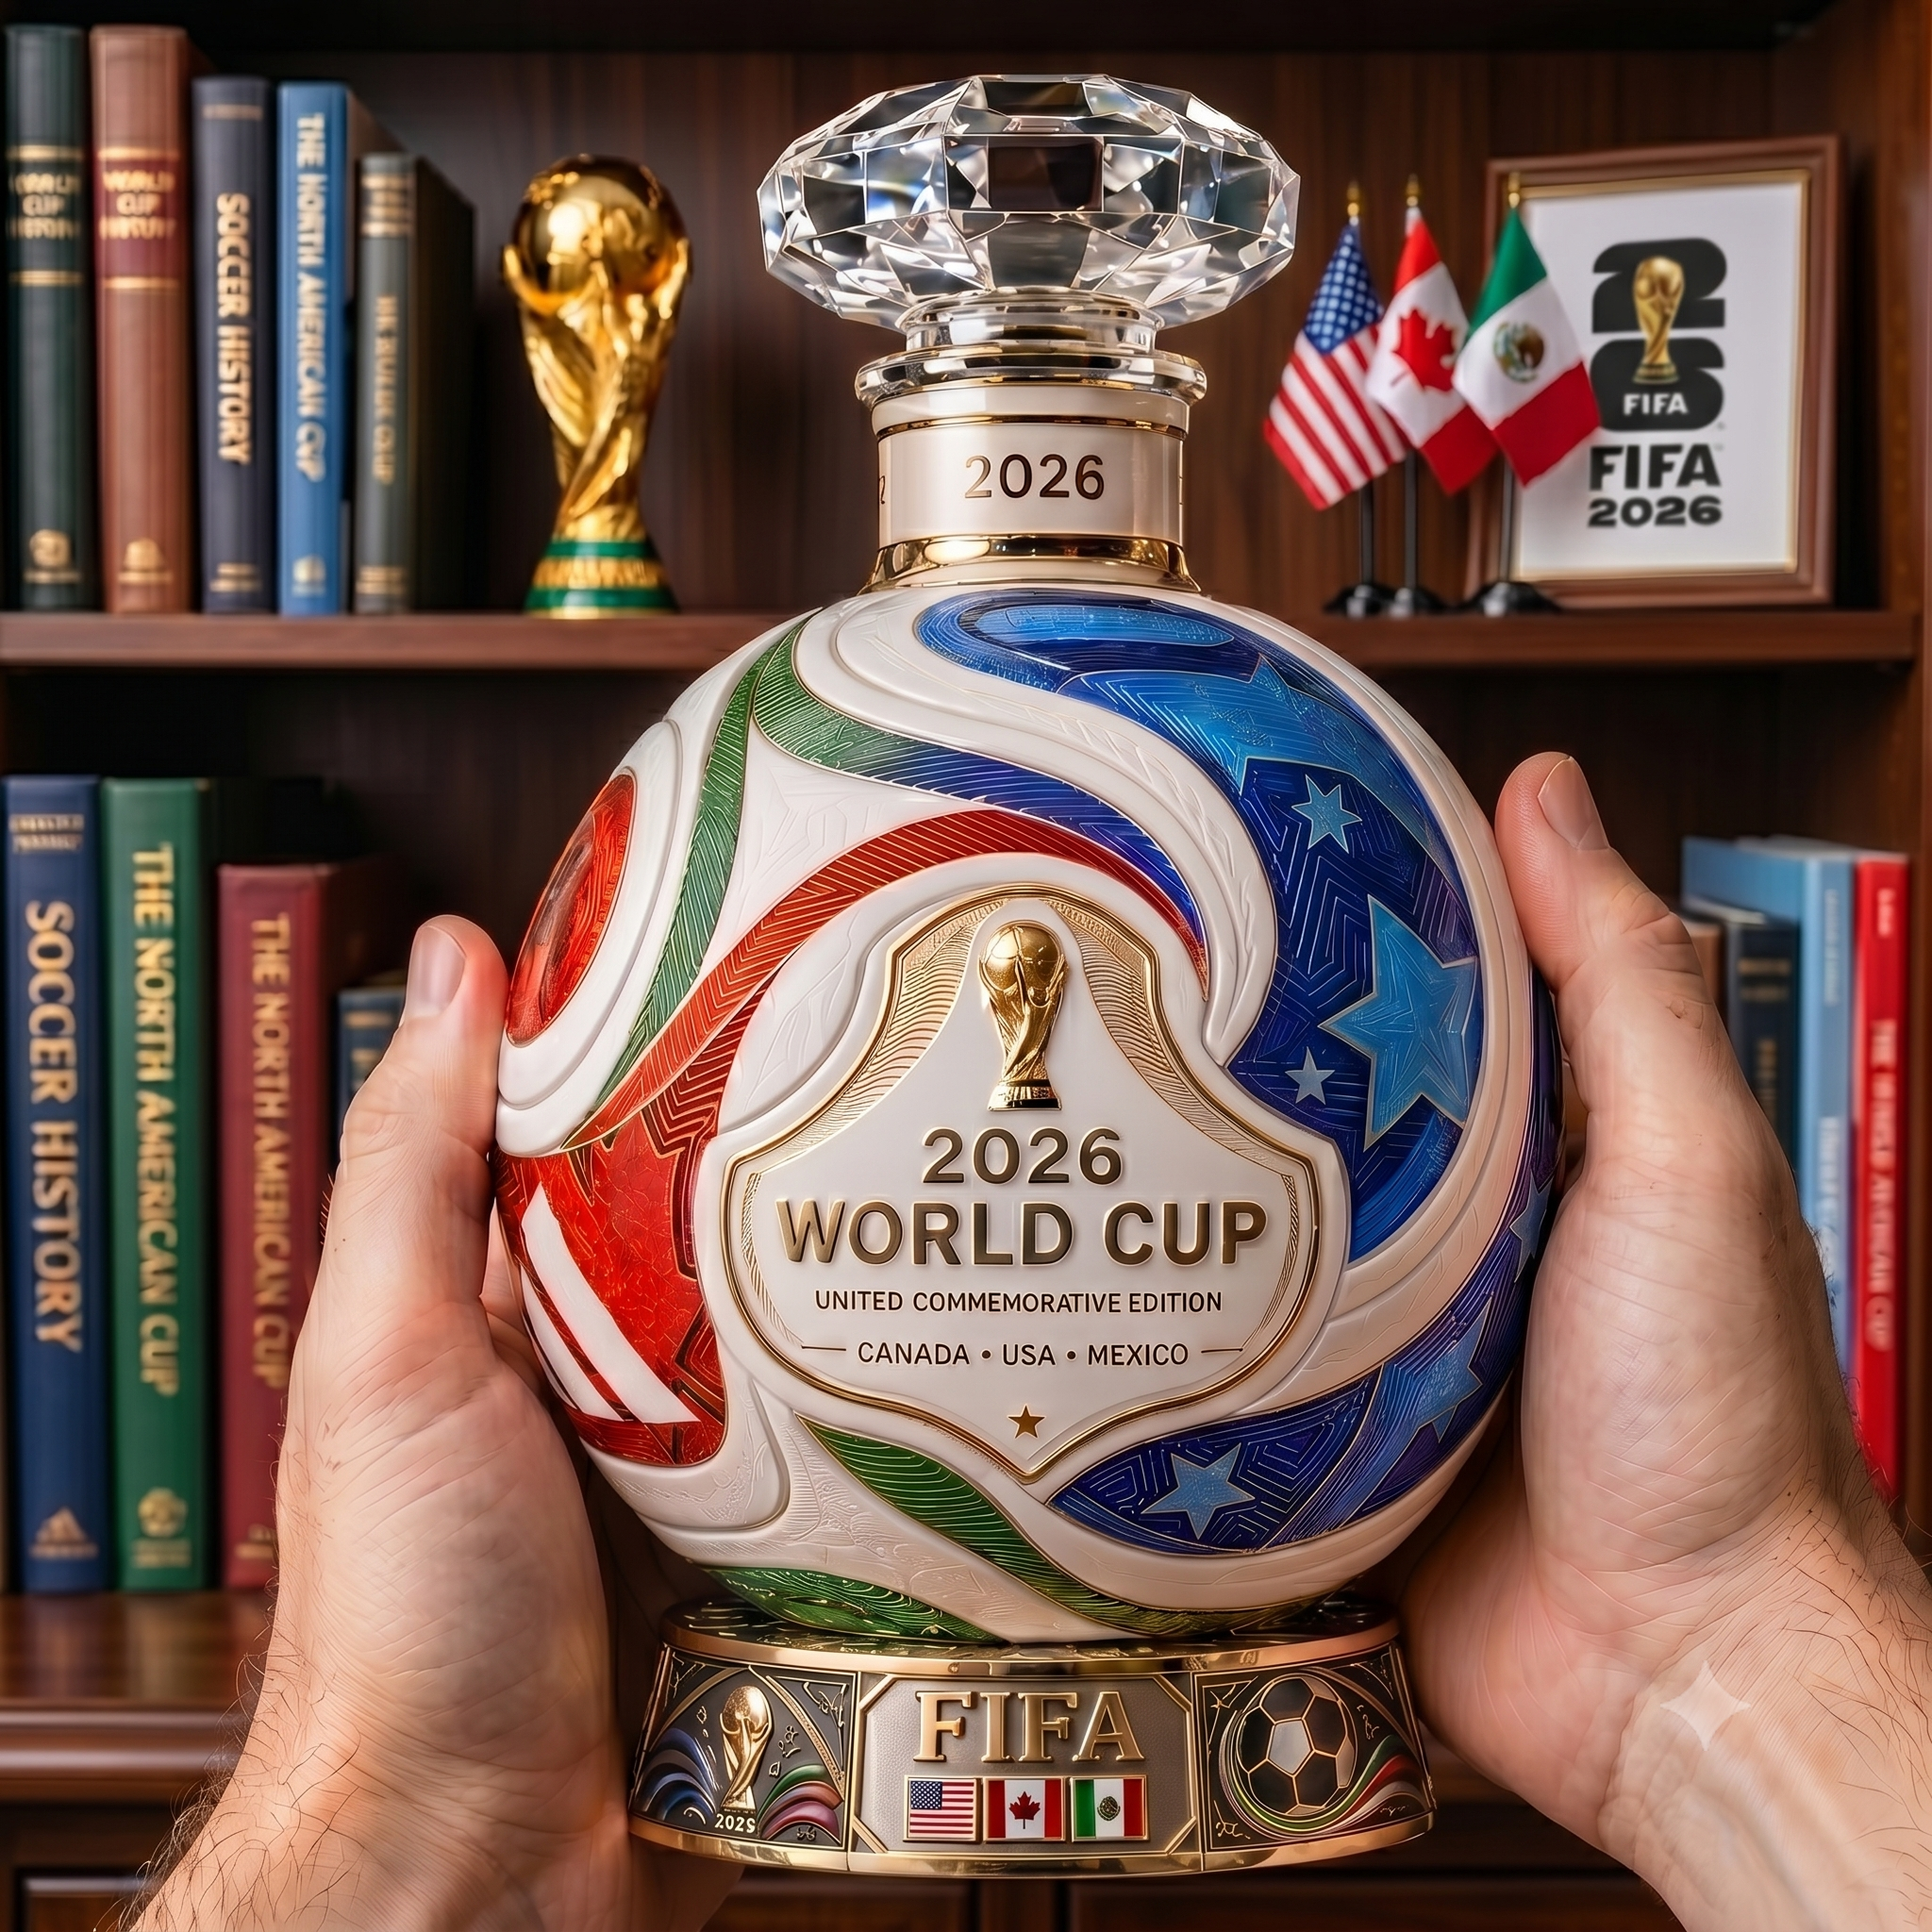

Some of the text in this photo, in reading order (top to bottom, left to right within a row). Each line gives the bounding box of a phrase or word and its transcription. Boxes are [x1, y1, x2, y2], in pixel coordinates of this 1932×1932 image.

[296, 113, 326, 167] THE
[217, 194, 252, 466] SOCCER HISTORY
[1623, 392, 1689, 416] FIFA
[964, 453, 1105, 500] 2026
[1589, 443, 1723, 491] FIFA
[1587, 495, 1724, 528] 2026
[25, 900, 79, 1104] SOCCER
[132, 843, 180, 1396] THE NORTH AMERICAN CUP
[251, 911, 291, 1390] THE NORTH AMERICAN CUP
[922, 1125, 1124, 1186] 2026
[32, 1121, 83, 1353] HISTORY
[774, 1198, 1268, 1267] WORLD CUP
[815, 1290, 1223, 1314] UNITED COMMEMORATIVE EDITION
[857, 1341, 1190, 1366] CANADA USA MEXICO
[911, 1689, 1147, 1763] FIFA
